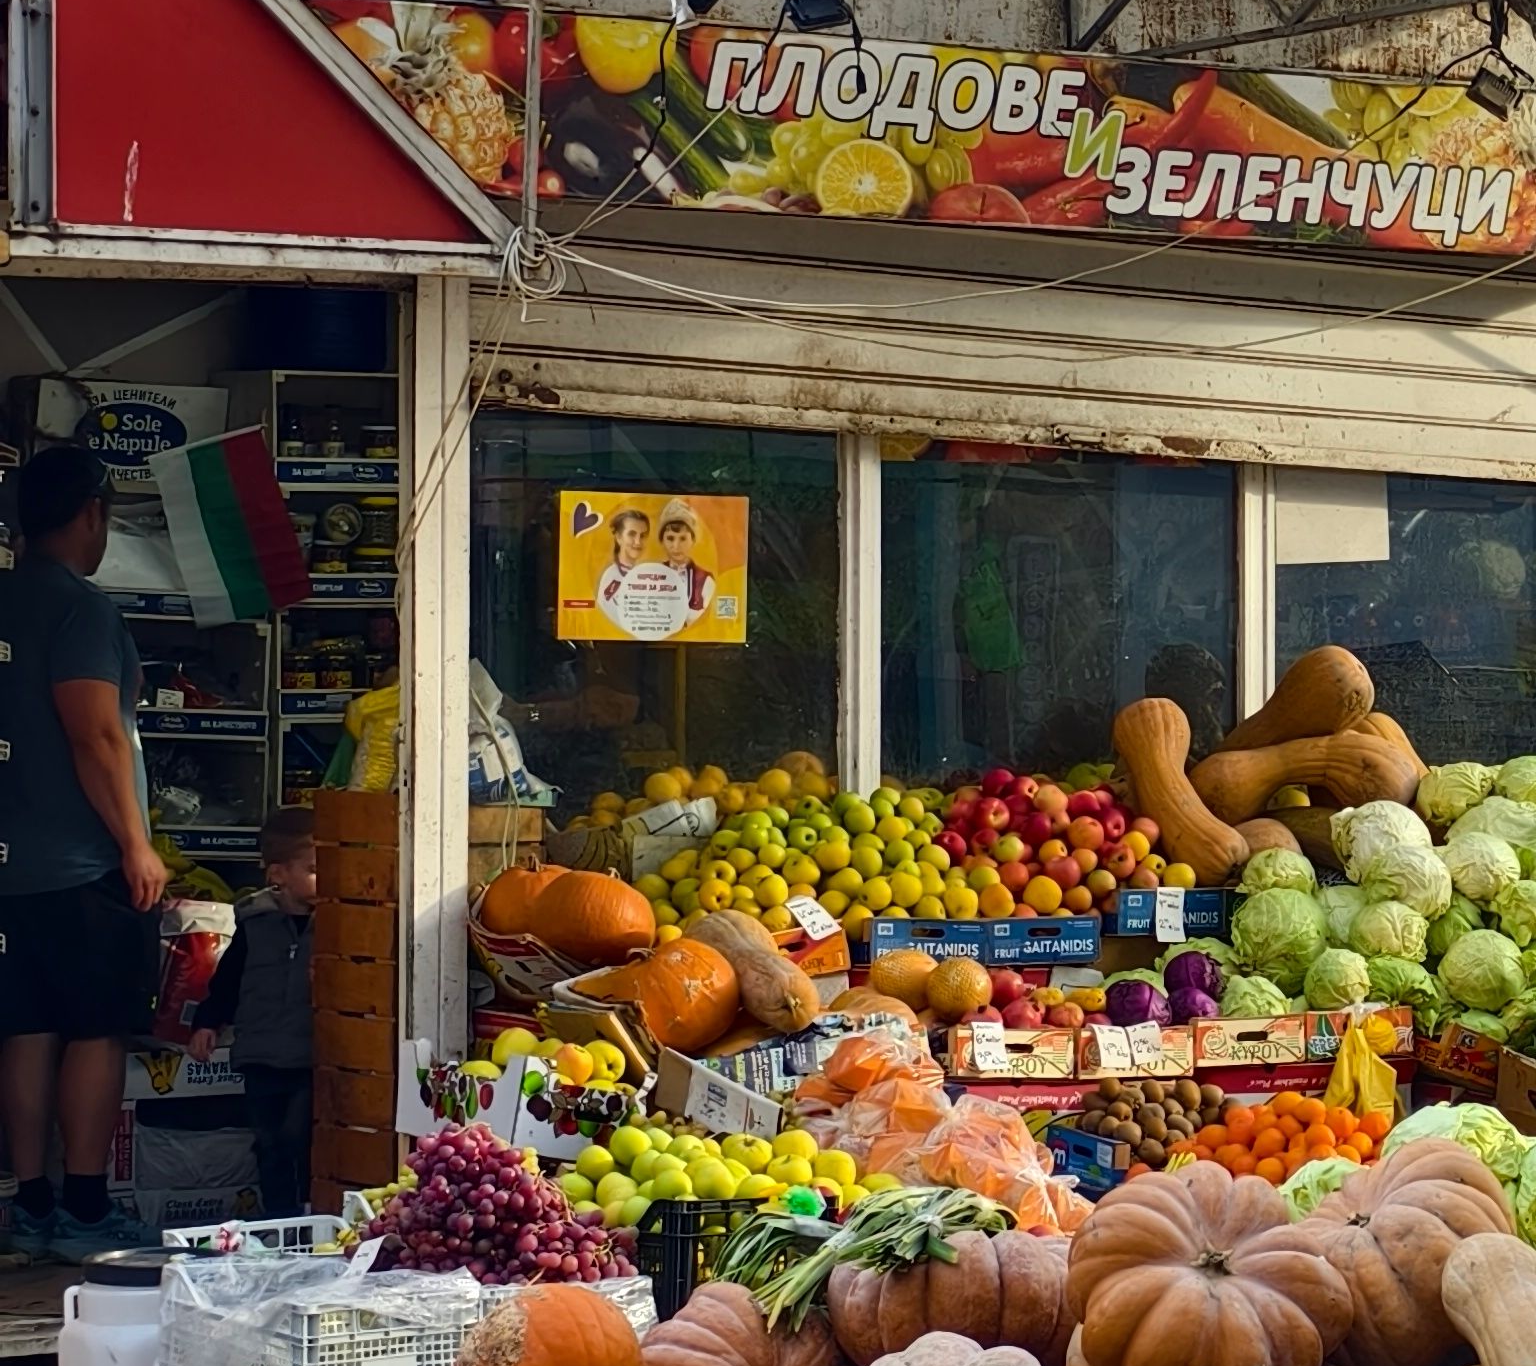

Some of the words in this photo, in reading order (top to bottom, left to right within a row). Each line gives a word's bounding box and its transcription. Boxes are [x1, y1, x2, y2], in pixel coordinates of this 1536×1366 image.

[704, 38, 1087, 144] ПЛОДОВЕ
[1064, 107, 1128, 181] И
[1105, 147, 1515, 248] ЗЕЛЕНЧУЦИ
[114, 389, 177, 410] ЦЕНИТЕЛИ
[121, 413, 162, 433] Sole
[102, 434, 171, 456] Napule
[1127, 918, 1150, 929] FRUIT
[1183, 912, 1219, 924] ANIDIS
[994, 948, 1020, 959] FRUIT
[188, 1062, 230, 1075] NANAS
